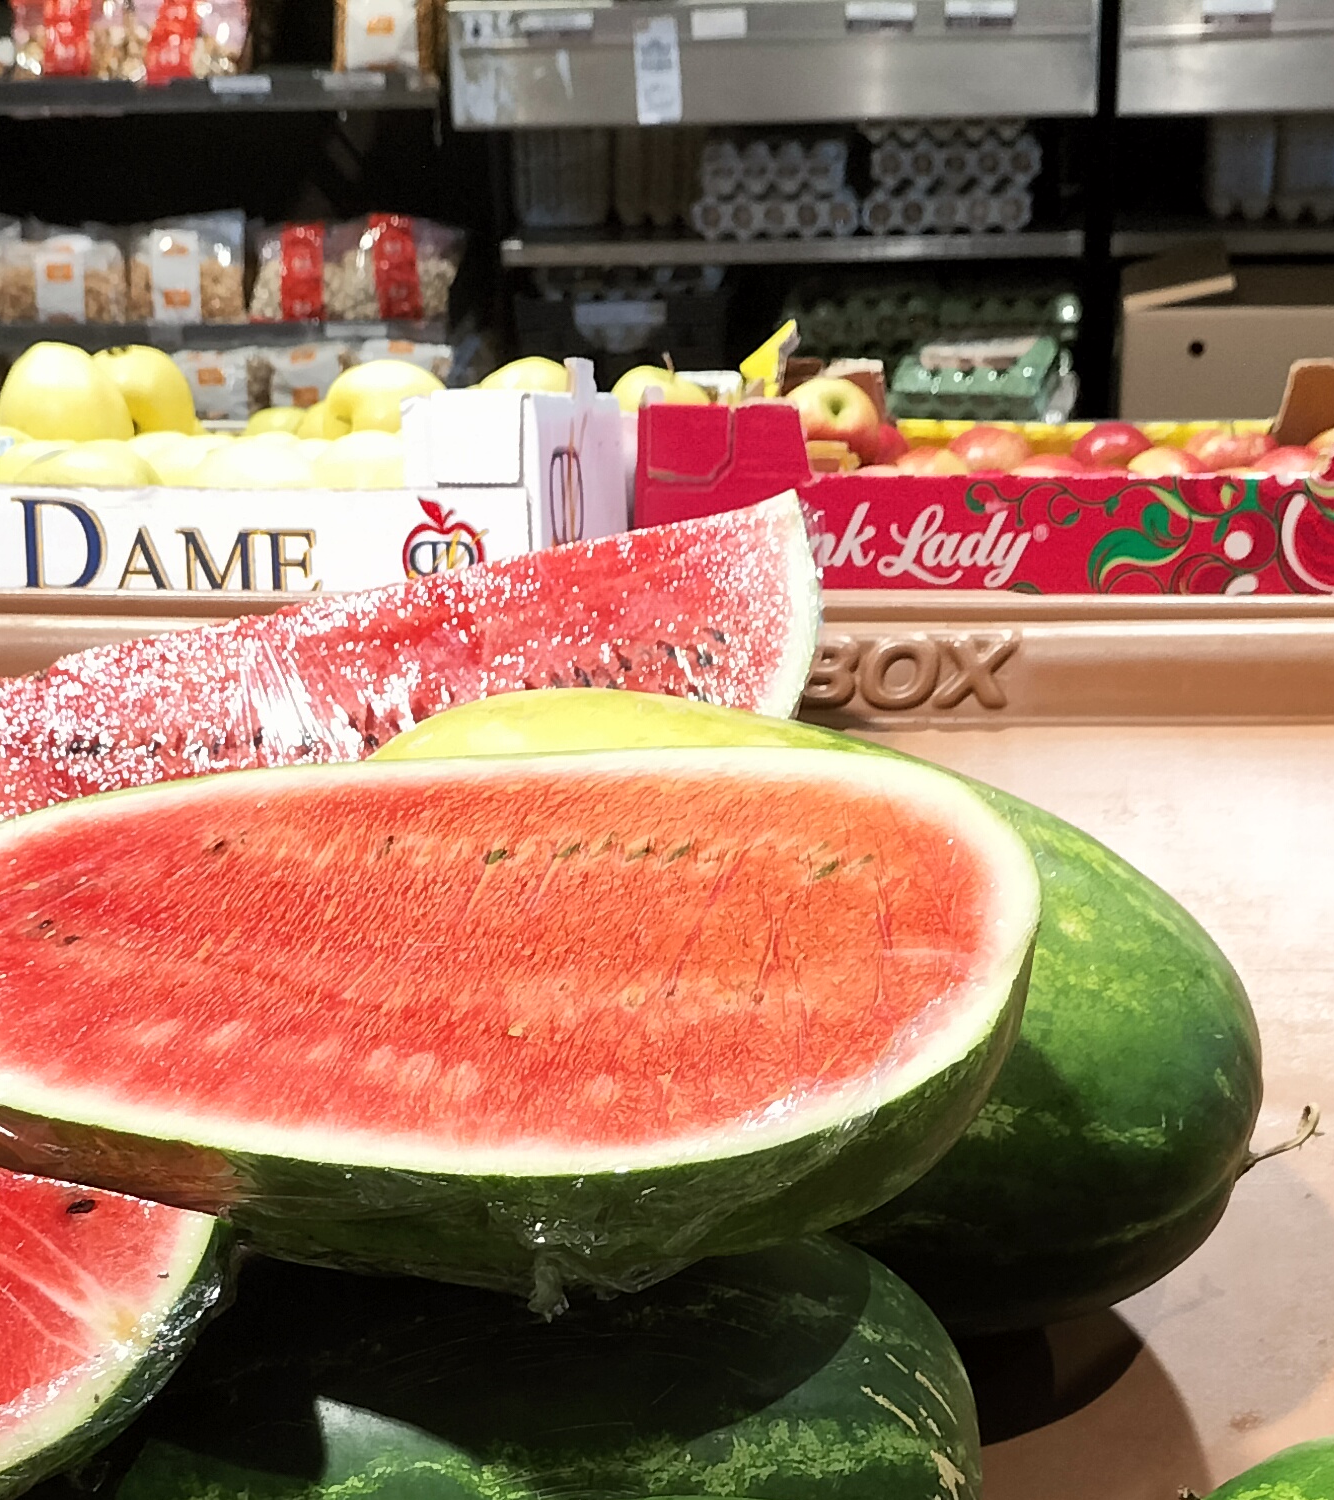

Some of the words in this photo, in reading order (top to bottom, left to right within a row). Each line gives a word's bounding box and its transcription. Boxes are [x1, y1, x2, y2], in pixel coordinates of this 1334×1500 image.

[11, 495, 323, 592] DAME
[809, 500, 877, 567] nk
[876, 503, 1032, 588] Lady
